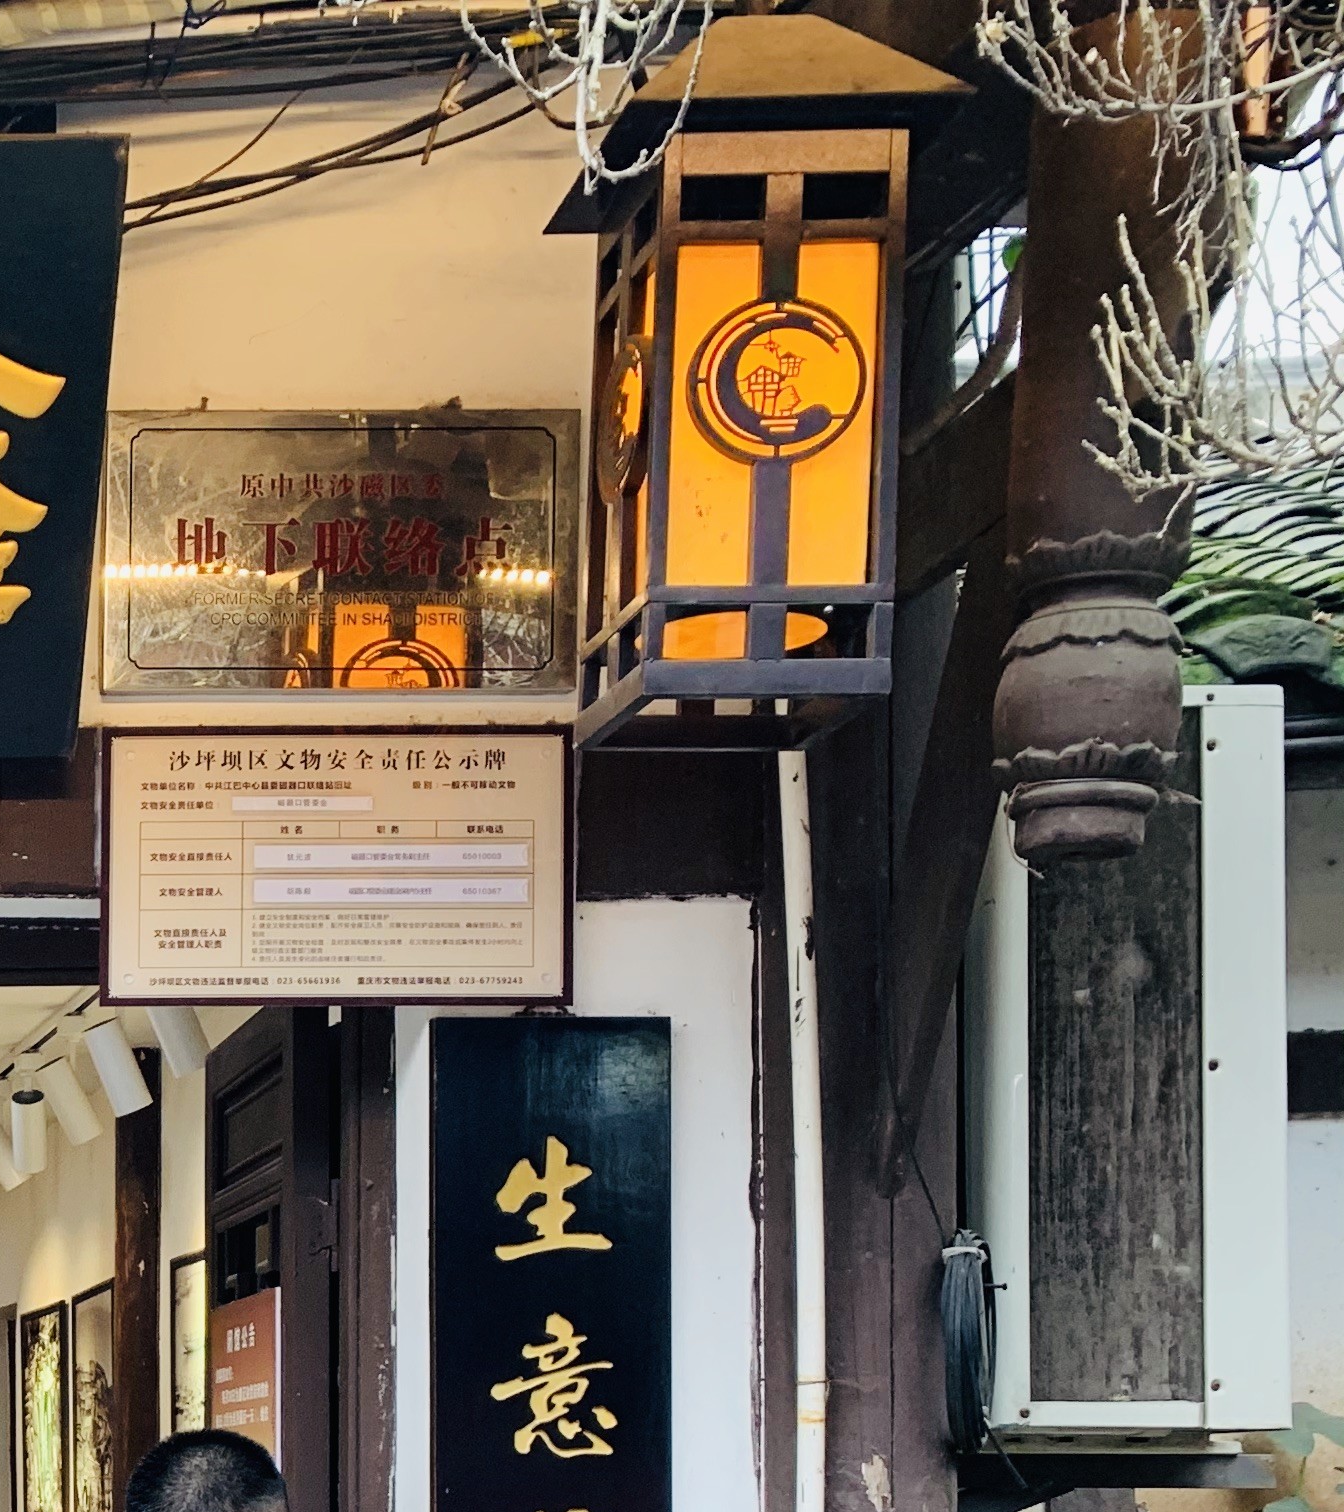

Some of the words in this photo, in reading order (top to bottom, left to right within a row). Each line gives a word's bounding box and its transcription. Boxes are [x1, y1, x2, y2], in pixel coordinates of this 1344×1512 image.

[171, 515, 515, 577] 地下联络点
[194, 592, 262, 606] FORMER
[264, 592, 325, 606] SECRET
[331, 592, 400, 606] CONTACT
[210, 612, 243, 627] CPC
[341, 612, 357, 627] IN
[168, 748, 508, 772] 沙坪坝区文物安全责任公示牌
[158, 887, 223, 897] 文物安全管理人
